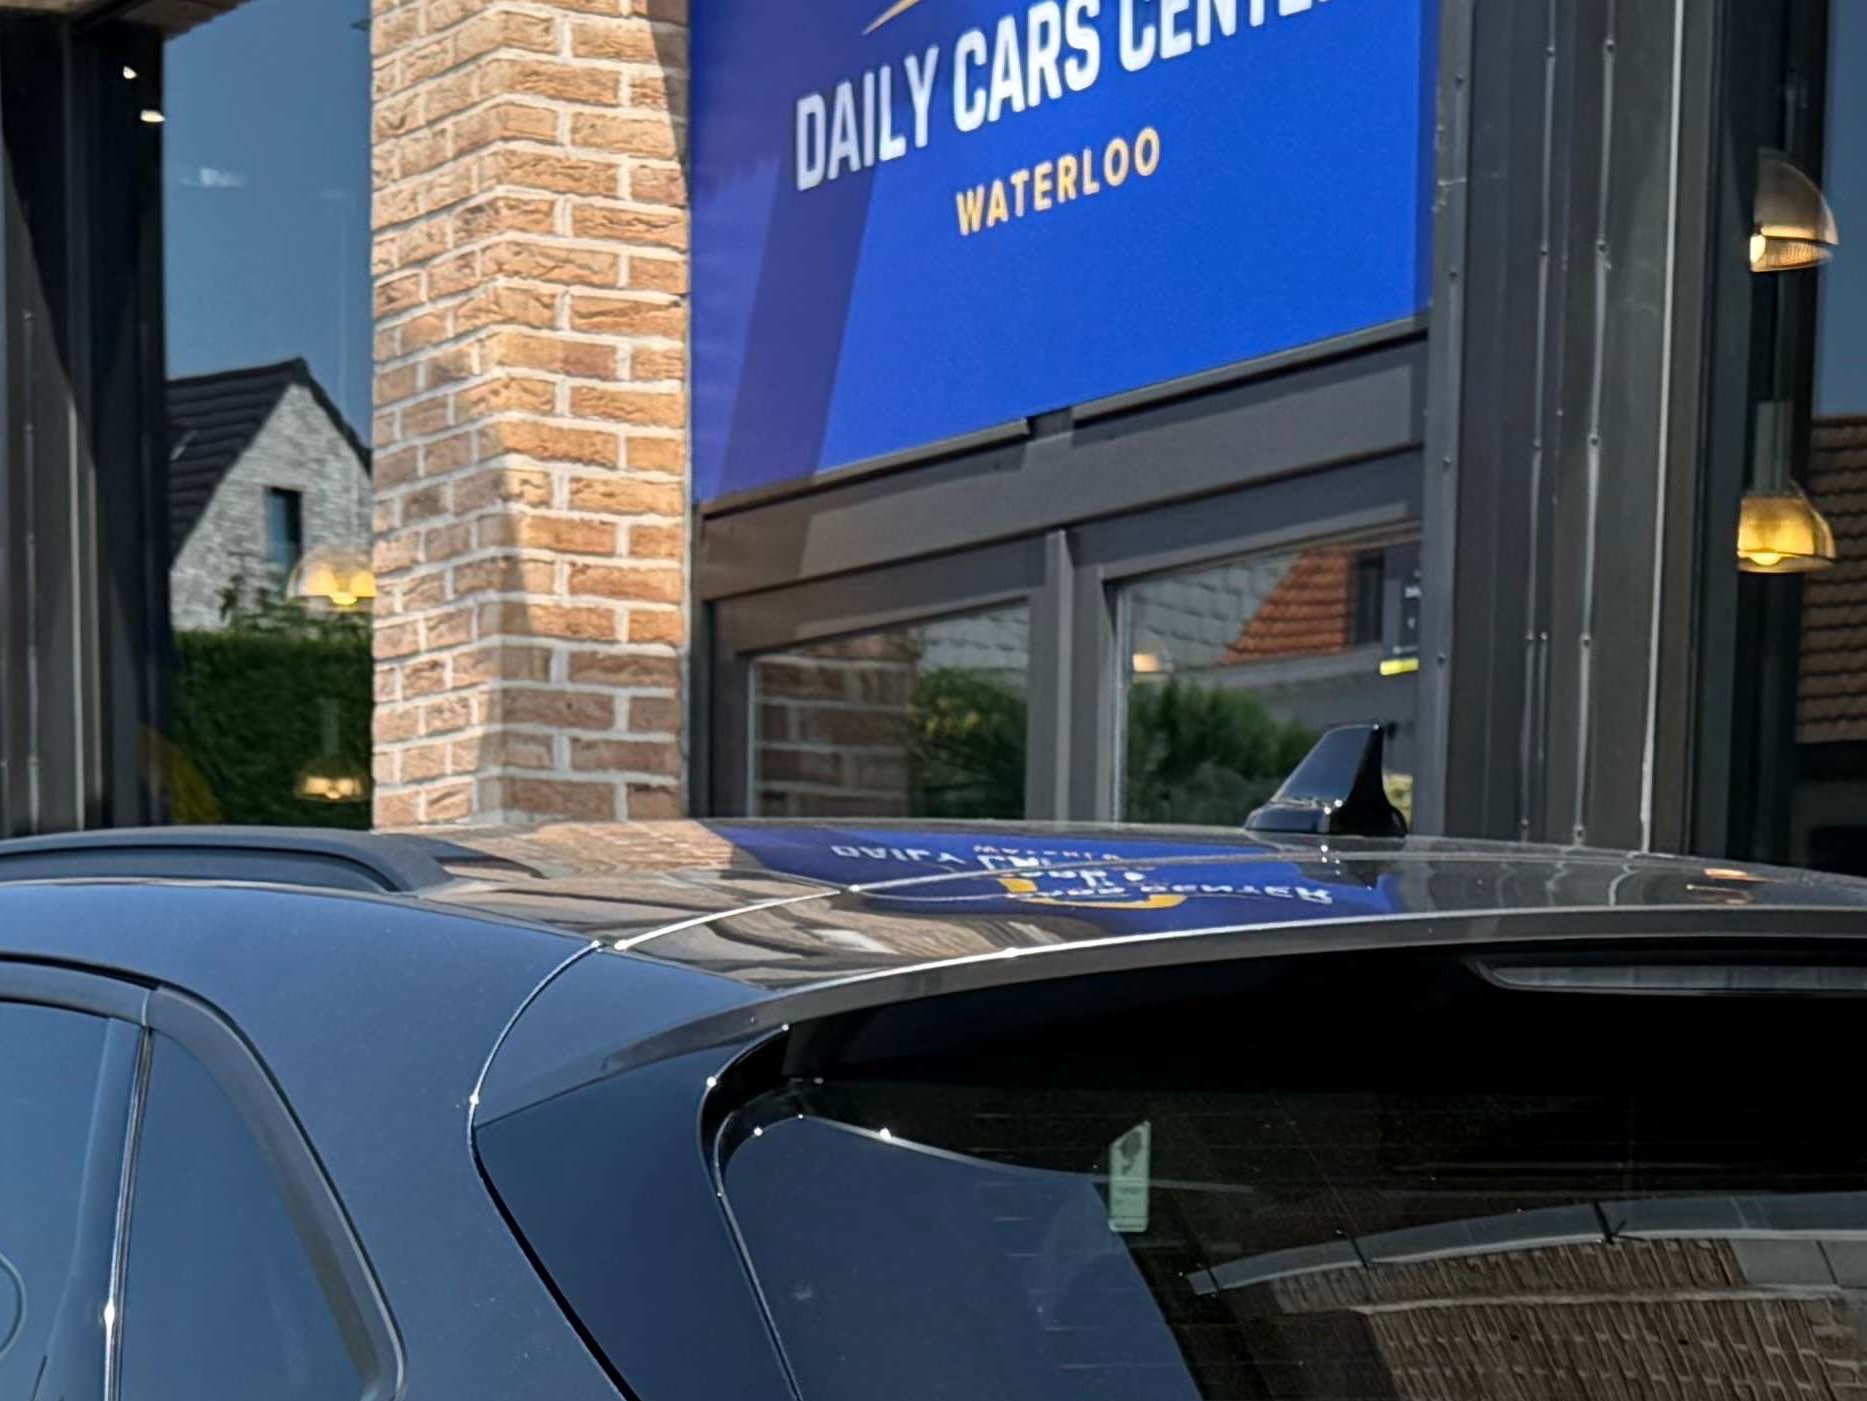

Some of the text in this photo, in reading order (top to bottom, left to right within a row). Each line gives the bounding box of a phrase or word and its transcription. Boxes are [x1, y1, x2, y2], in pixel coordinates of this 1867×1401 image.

[794, 45, 940, 192] DAILY
[952, 0, 1101, 133] CARS
[955, 127, 1160, 236] WATERLOO
